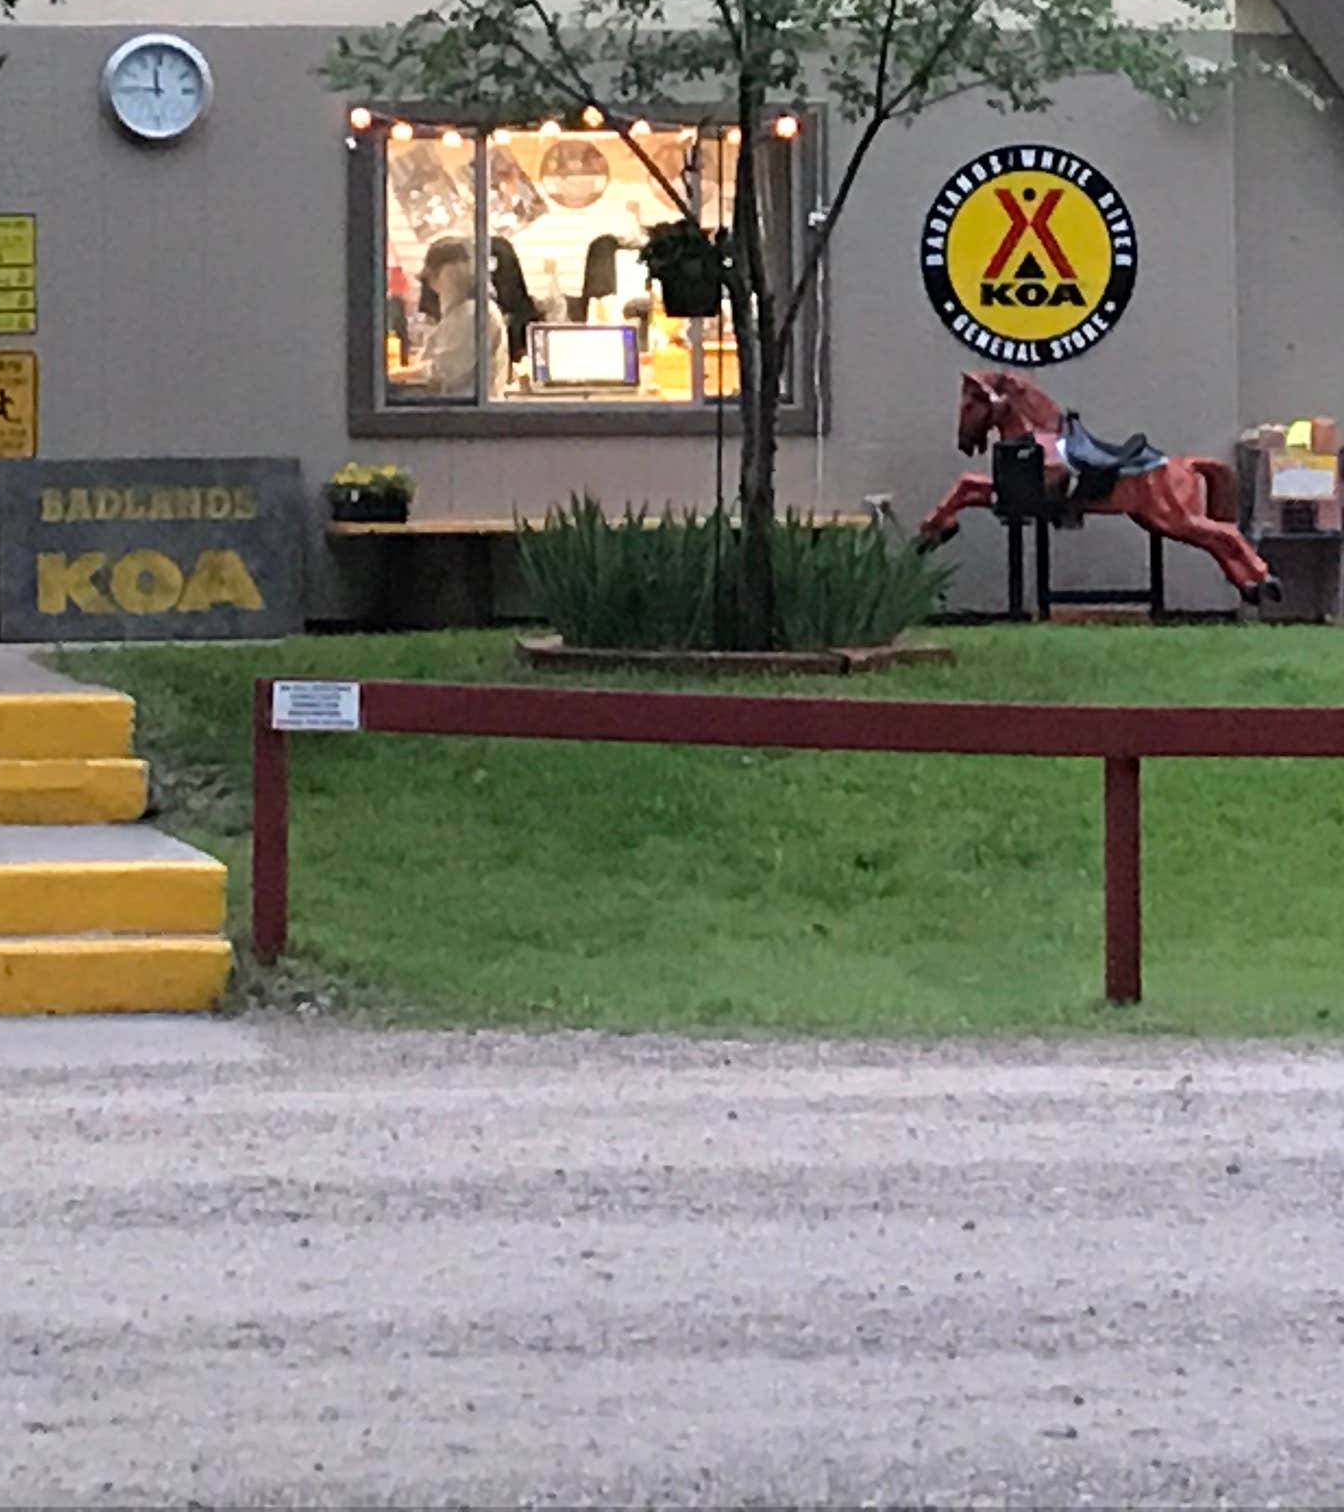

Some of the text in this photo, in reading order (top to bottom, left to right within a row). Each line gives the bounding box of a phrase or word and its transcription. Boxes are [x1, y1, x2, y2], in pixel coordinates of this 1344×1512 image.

[925, 154, 1003, 266] BADLANDS
[1019, 148, 1093, 187] WHITE
[1098, 191, 1133, 267] RIVER
[979, 283, 1088, 307] KOA
[952, 312, 1110, 362] GENERAL STORE
[40, 486, 256, 524] BADLANDS
[35, 548, 267, 615] KOA
